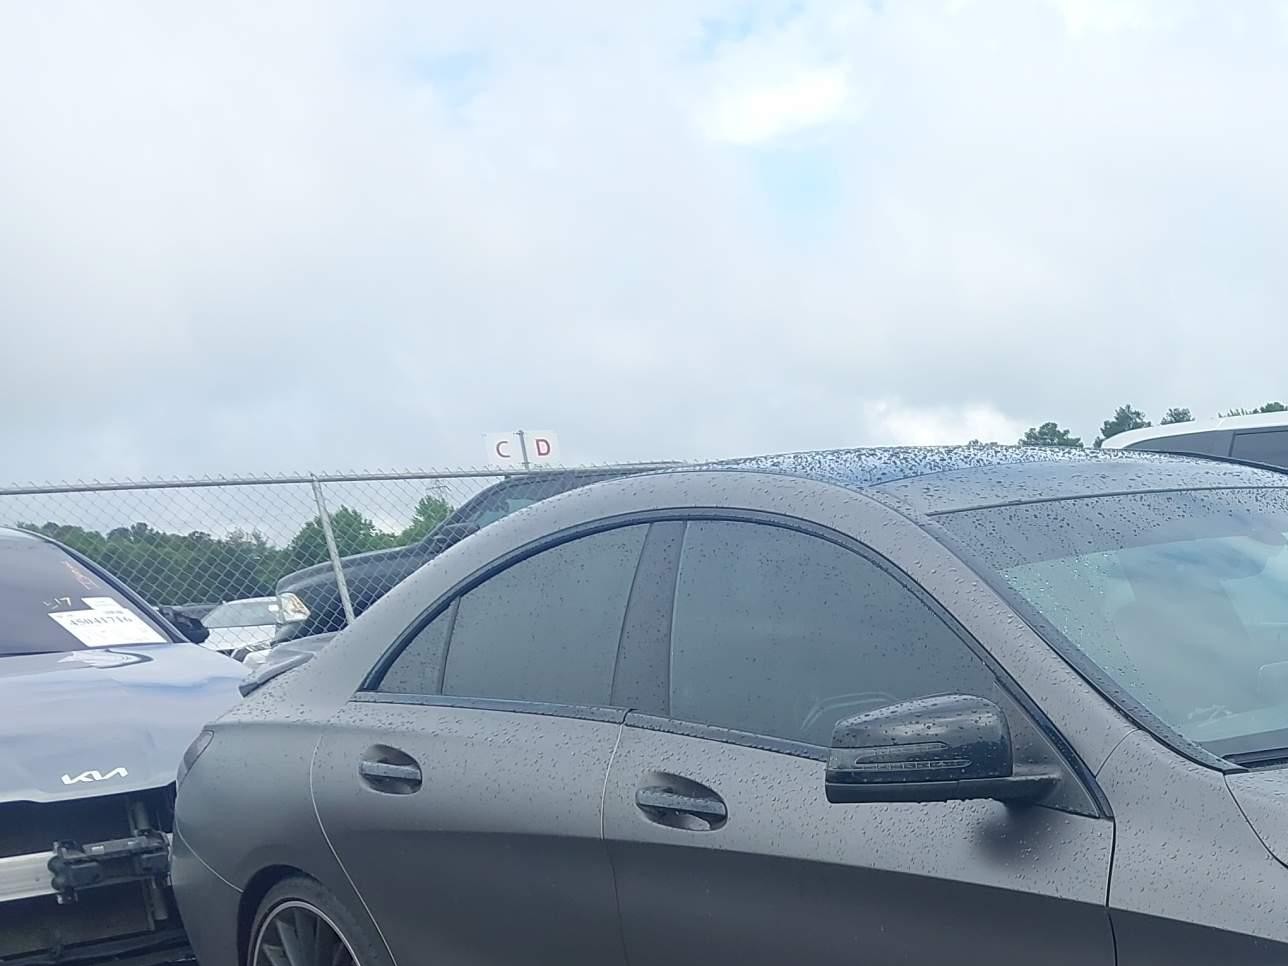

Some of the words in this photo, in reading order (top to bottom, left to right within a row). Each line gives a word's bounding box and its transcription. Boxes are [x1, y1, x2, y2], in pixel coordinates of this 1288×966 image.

[495, 440, 511, 458] C
[535, 438, 551, 457] D
[61, 767, 128, 785] KIA
